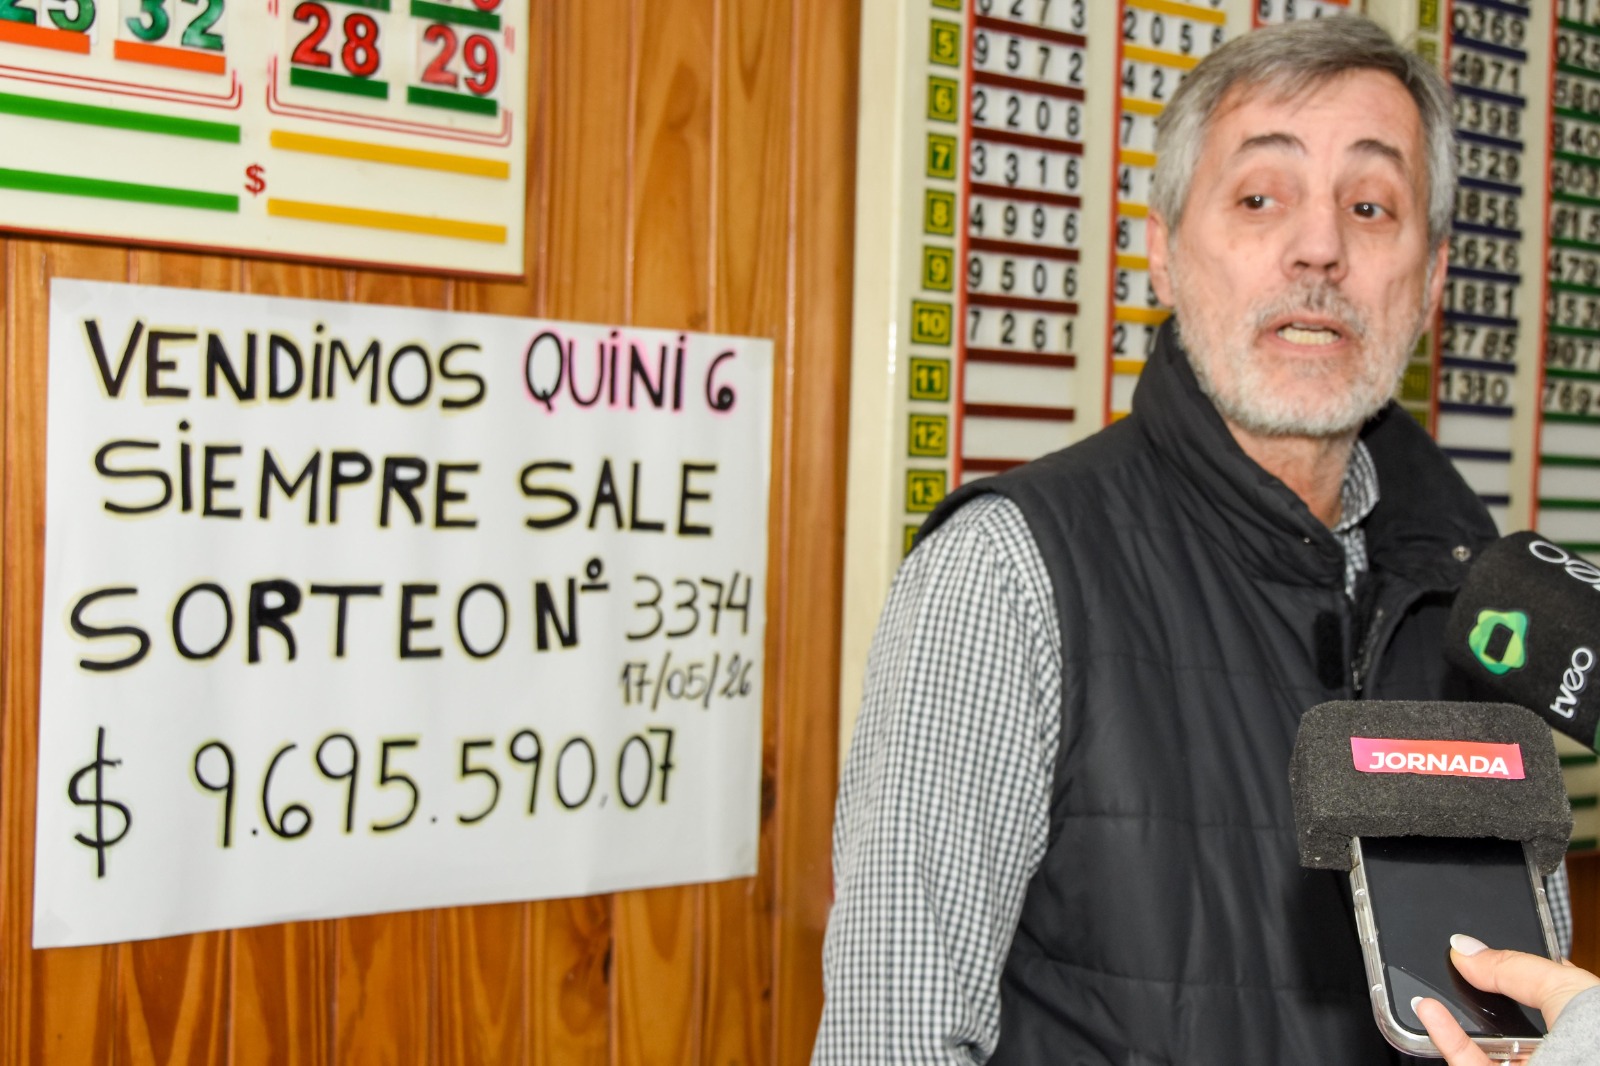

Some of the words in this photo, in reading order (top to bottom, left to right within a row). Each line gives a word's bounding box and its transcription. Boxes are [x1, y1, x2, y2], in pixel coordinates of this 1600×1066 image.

[291, 1, 380, 78] 28
[421, 23, 498, 96] 29
[974, 33, 1083, 83] 9572
[936, 87, 950, 111] 6
[974, 90, 1081, 137] 2208
[245, 164, 267, 196] $
[935, 144, 948, 169] 7
[972, 145, 1079, 189] 3316
[934, 203, 947, 226] 8
[970, 202, 1078, 250] 4996
[932, 258, 946, 282] 9
[968, 257, 1077, 298] 9506
[921, 311, 945, 335] 10
[969, 309, 1074, 351] 7261
[706, 350, 737, 412] 6
[918, 366, 941, 390] 11
[917, 425, 943, 449] 12
[519, 459, 719, 536] SALE
[69, 578, 509, 671] SORTEO
[626, 571, 752, 641] 3374
[621, 650, 753, 711] 17/05/26
[1550, 647, 1594, 719] tveo
[1369, 752, 1509, 776] JORNADA
[68, 726, 133, 878] $
